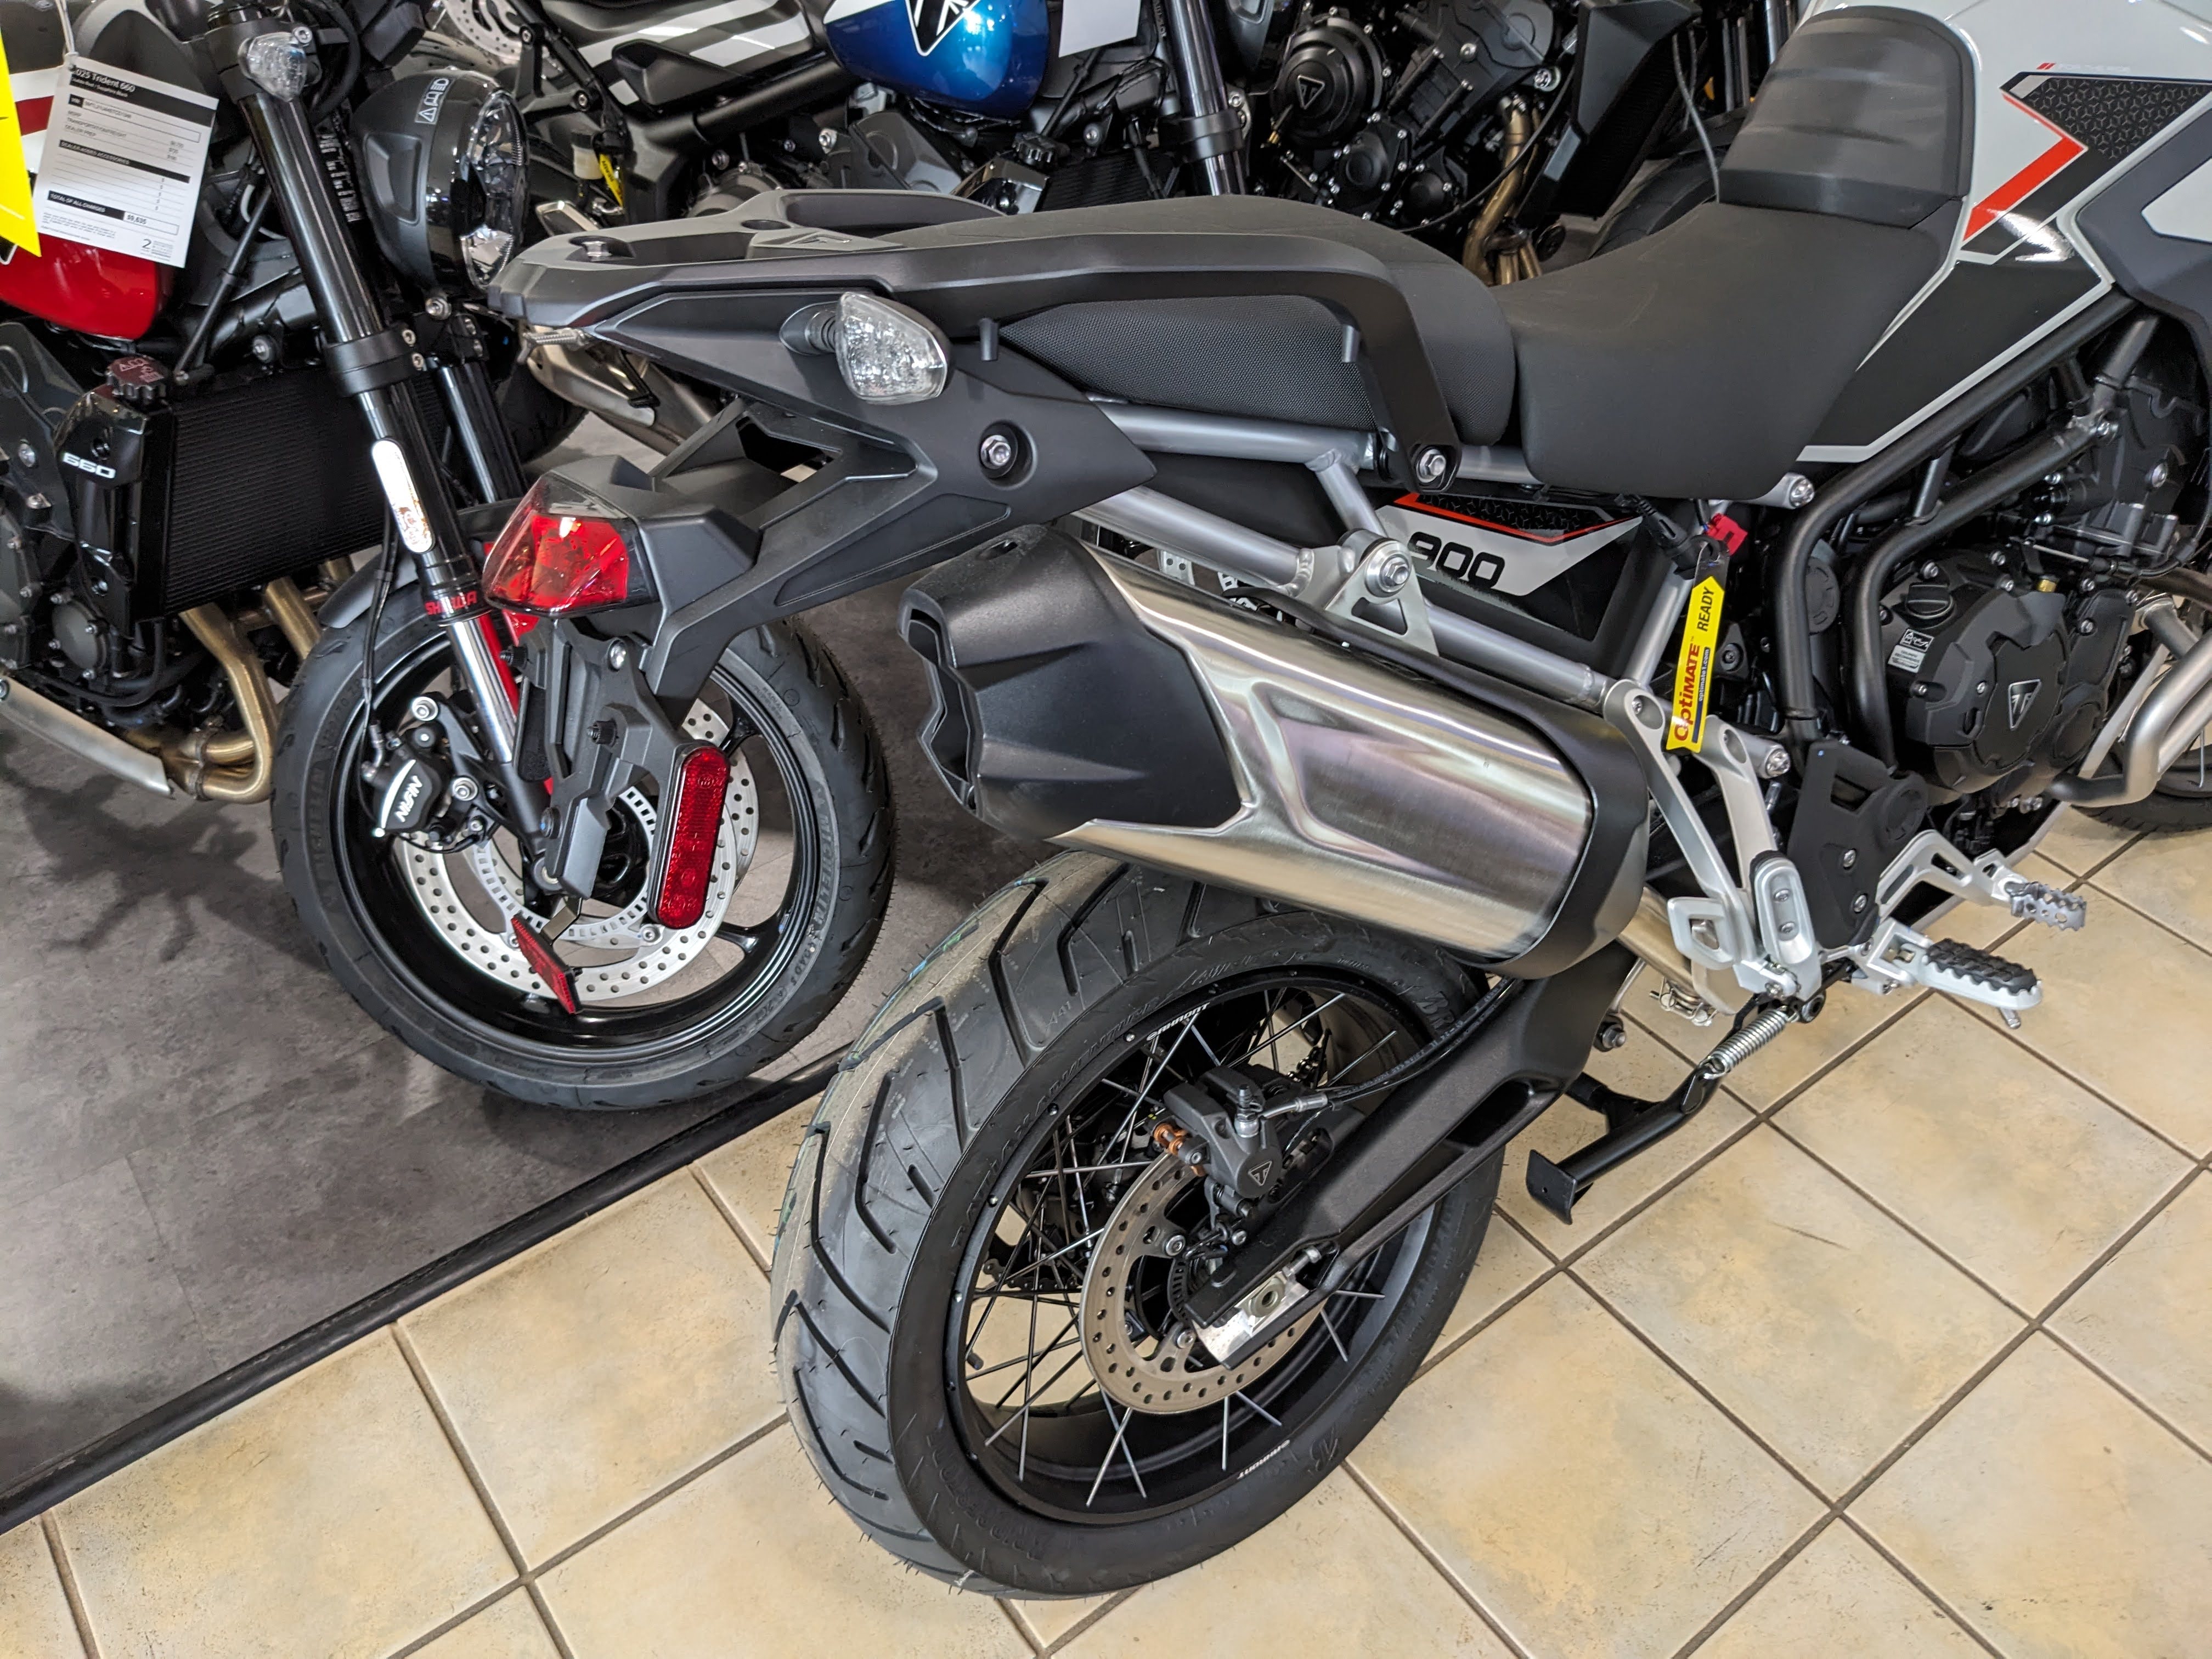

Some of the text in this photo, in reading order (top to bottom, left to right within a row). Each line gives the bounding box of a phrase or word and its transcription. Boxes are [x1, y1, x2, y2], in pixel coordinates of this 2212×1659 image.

[91, 73, 120, 88] Trident
[119, 82, 136, 92] 660
[142, 239, 151, 250] 2
[63, 452, 116, 479] 660
[1408, 531, 1505, 590] 900
[425, 590, 477, 615] SHWA
[1697, 586, 1714, 631] READY
[812, 814, 833, 926] MICHELIN
